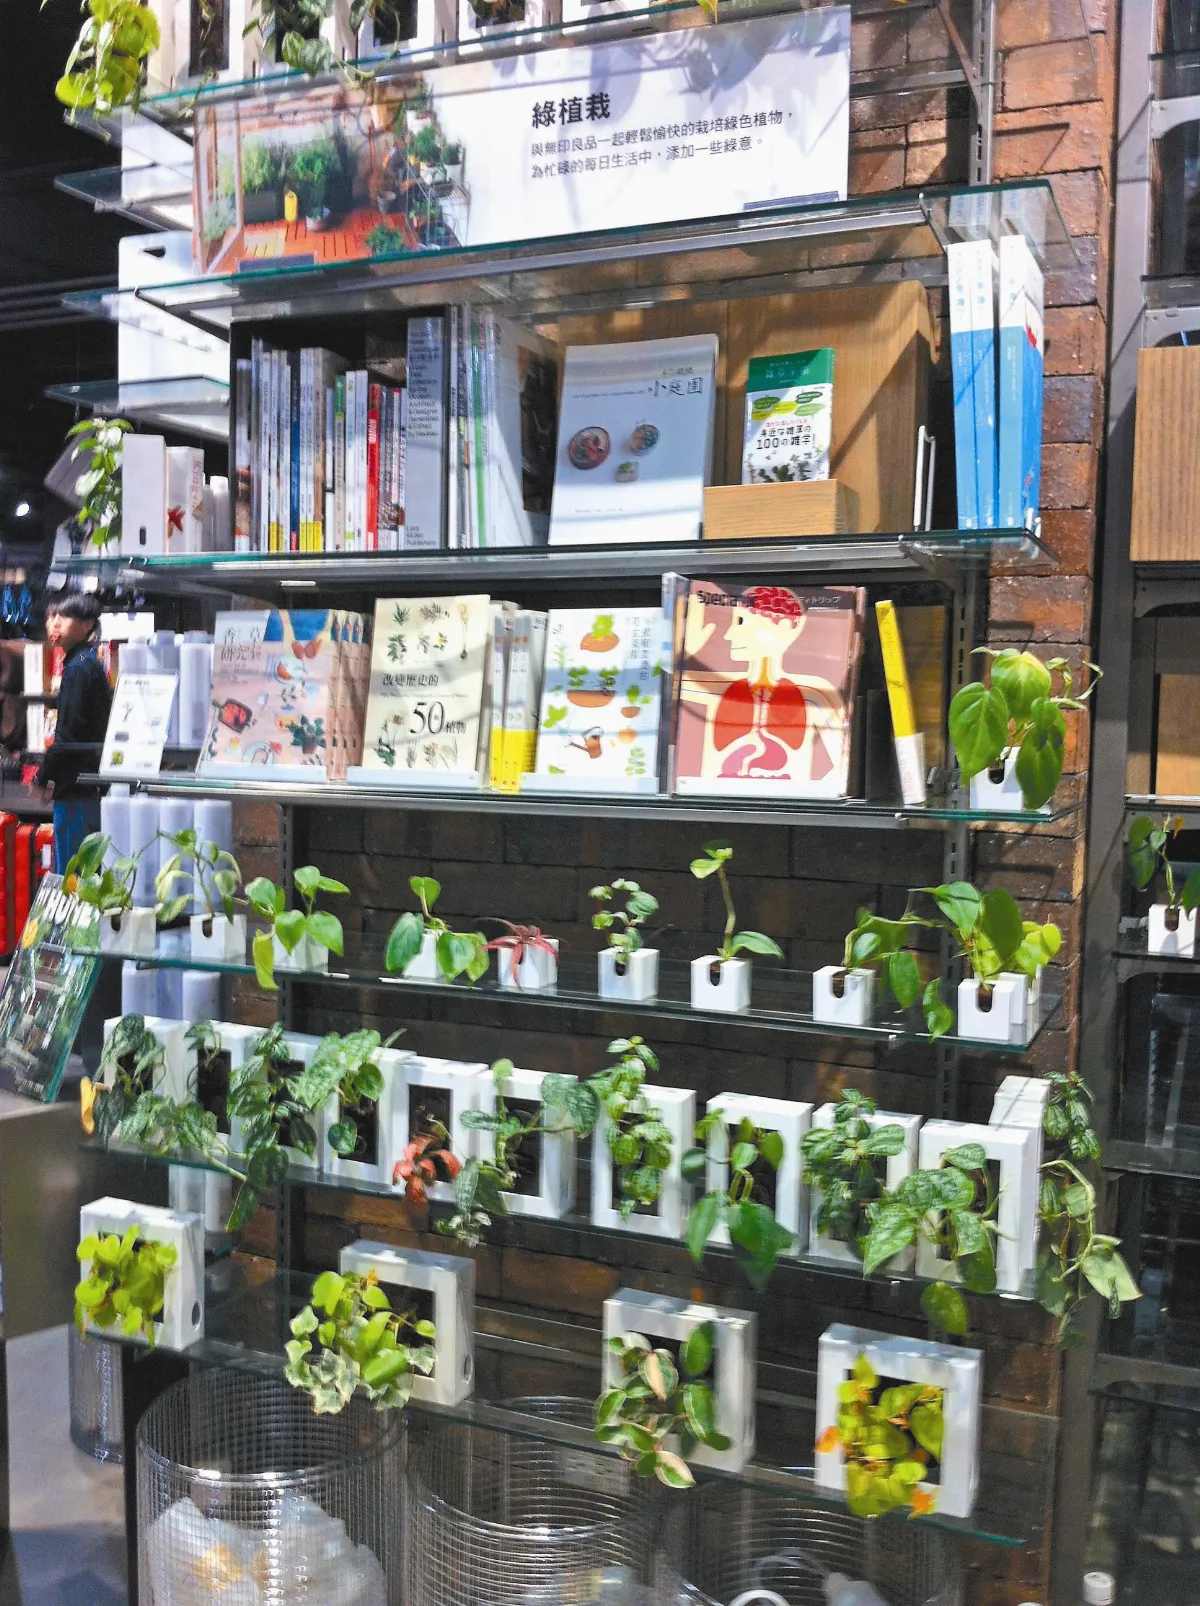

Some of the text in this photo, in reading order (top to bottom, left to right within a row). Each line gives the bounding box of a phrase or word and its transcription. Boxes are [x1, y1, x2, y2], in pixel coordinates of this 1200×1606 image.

[531, 92, 611, 129] 綠植栽
[408, 701, 446, 735] 50
